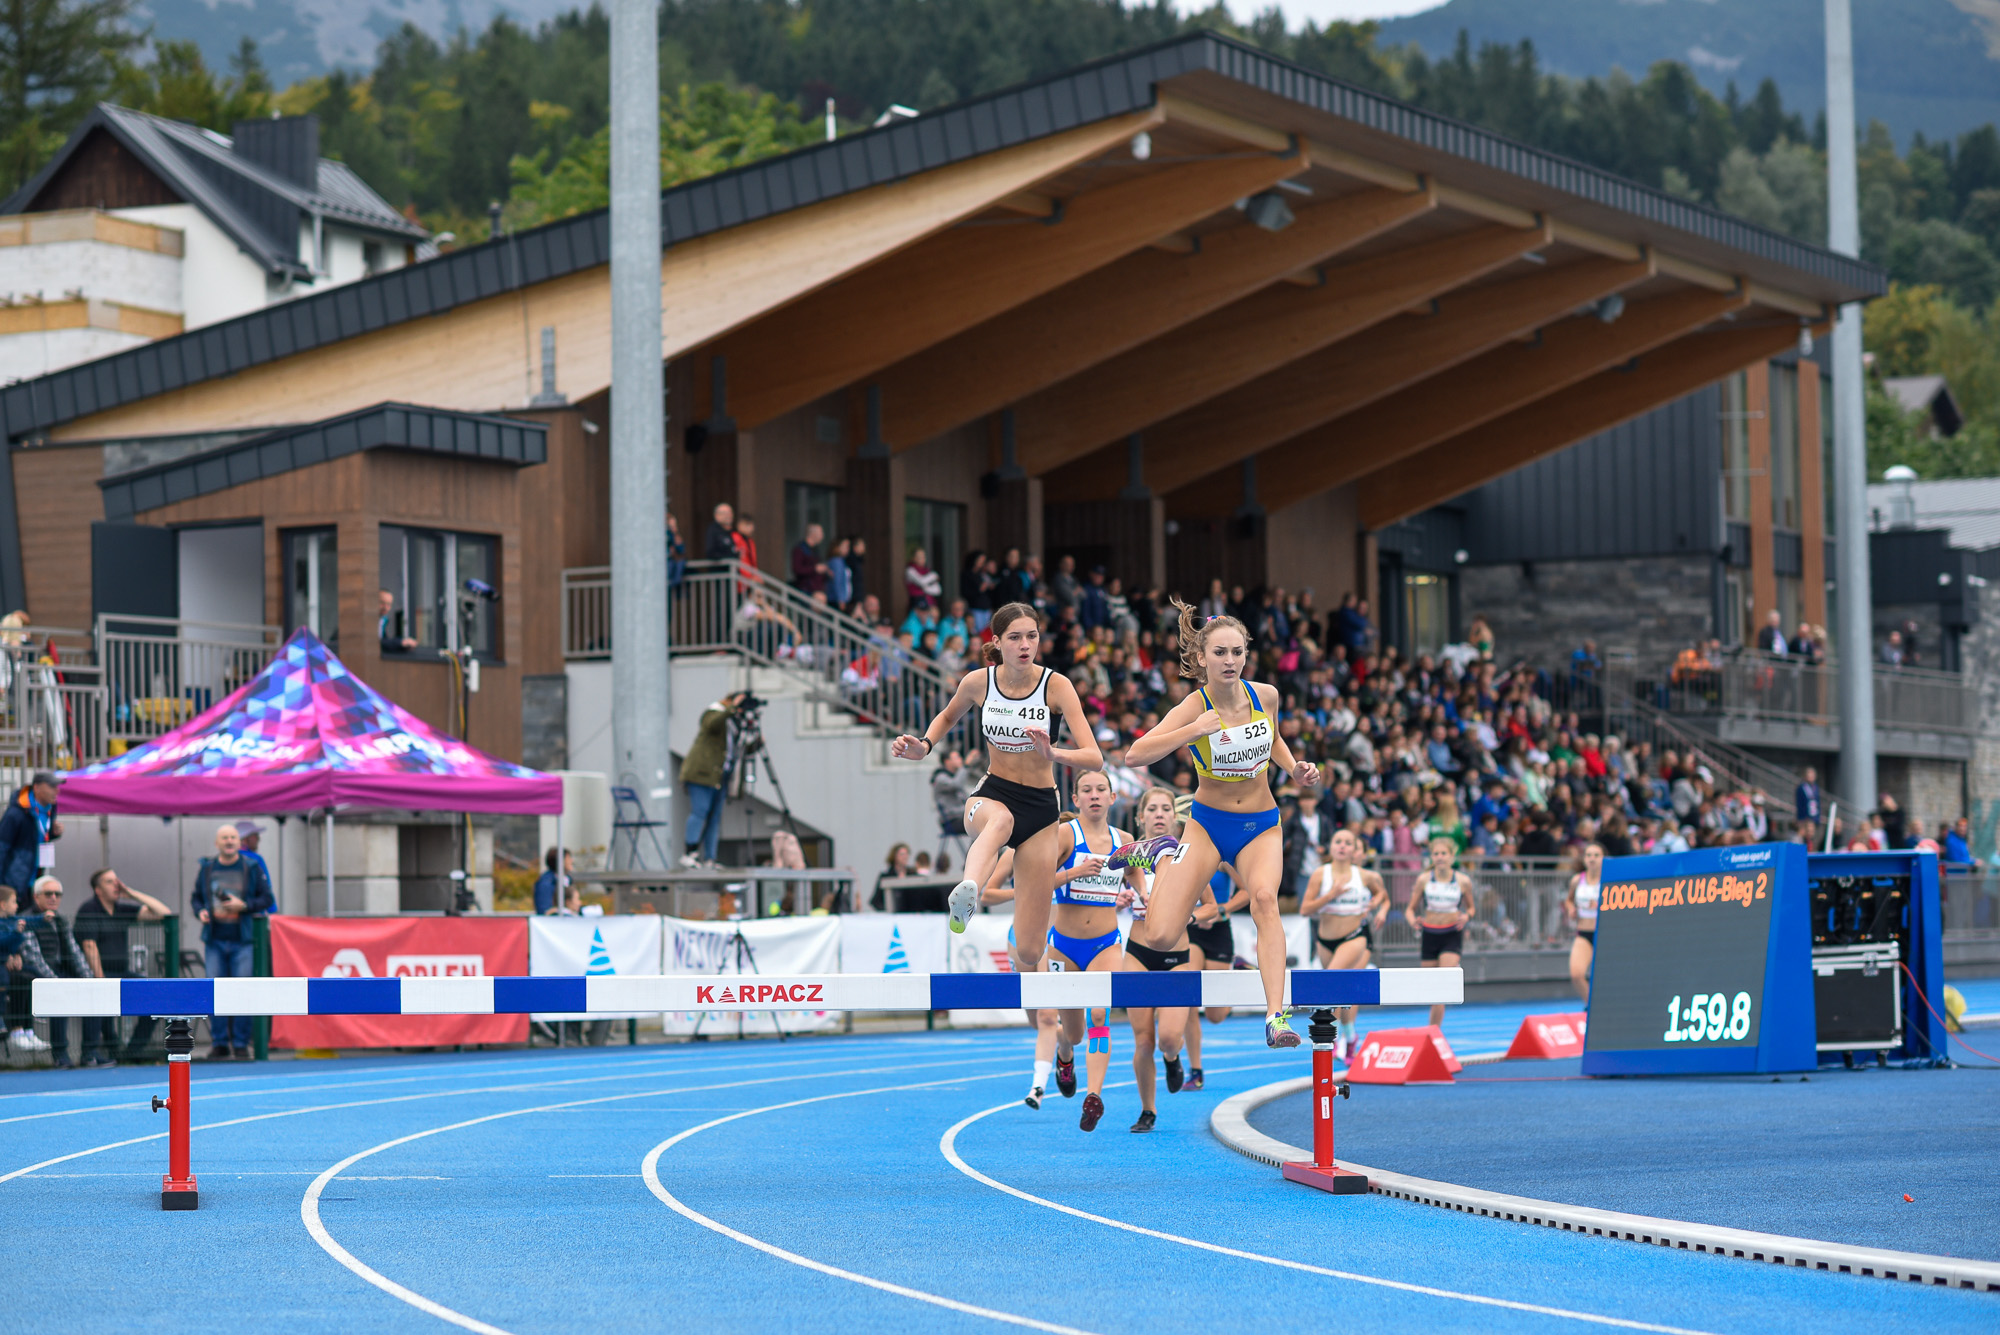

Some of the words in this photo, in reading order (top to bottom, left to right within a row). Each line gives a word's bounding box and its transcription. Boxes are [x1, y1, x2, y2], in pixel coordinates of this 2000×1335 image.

[1018, 707, 1045, 721] 418
[1245, 722, 1267, 740] 525
[1600, 883, 1649, 911] 1000m
[1755, 872, 1767, 899] 2
[1663, 991, 1751, 1042] 1:59.8
